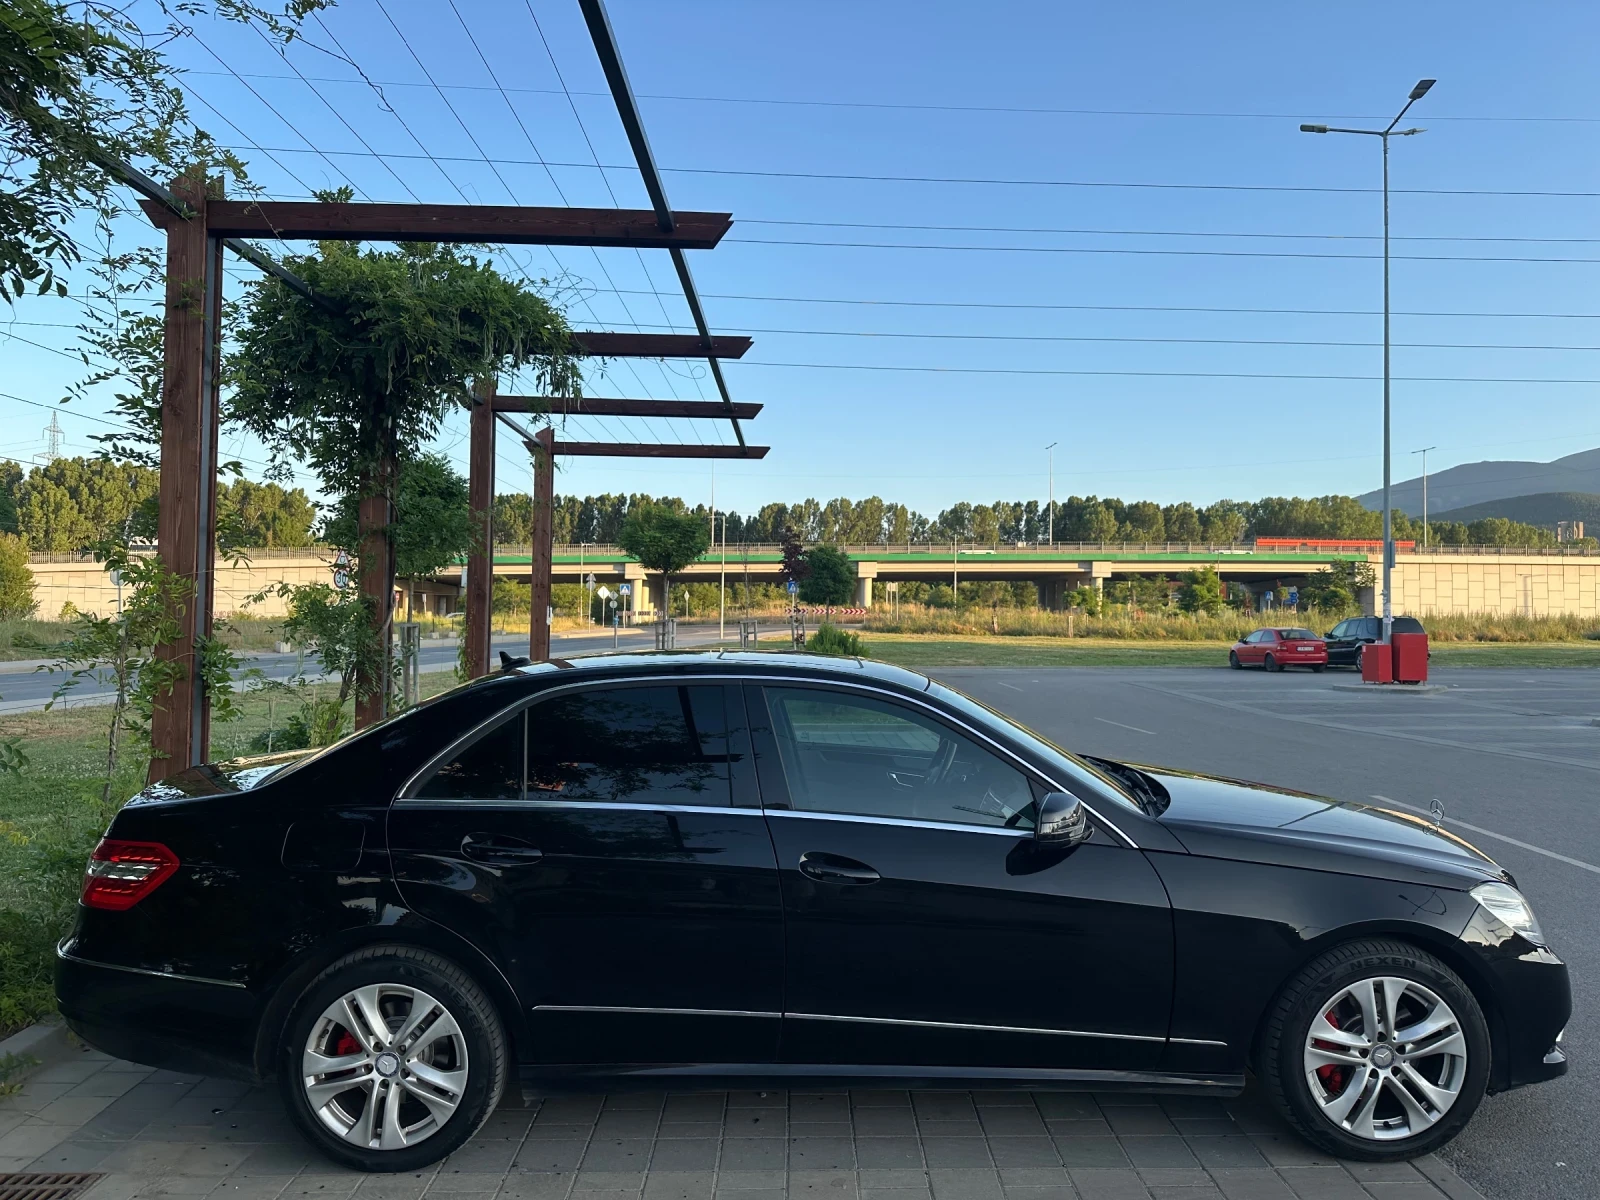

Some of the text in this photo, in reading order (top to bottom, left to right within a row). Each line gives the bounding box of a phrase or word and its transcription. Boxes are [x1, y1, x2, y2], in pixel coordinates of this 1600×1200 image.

[336, 571, 347, 583] 30
[1349, 956, 1416, 971] NEXEN
[440, 981, 484, 1036] NEXEN
